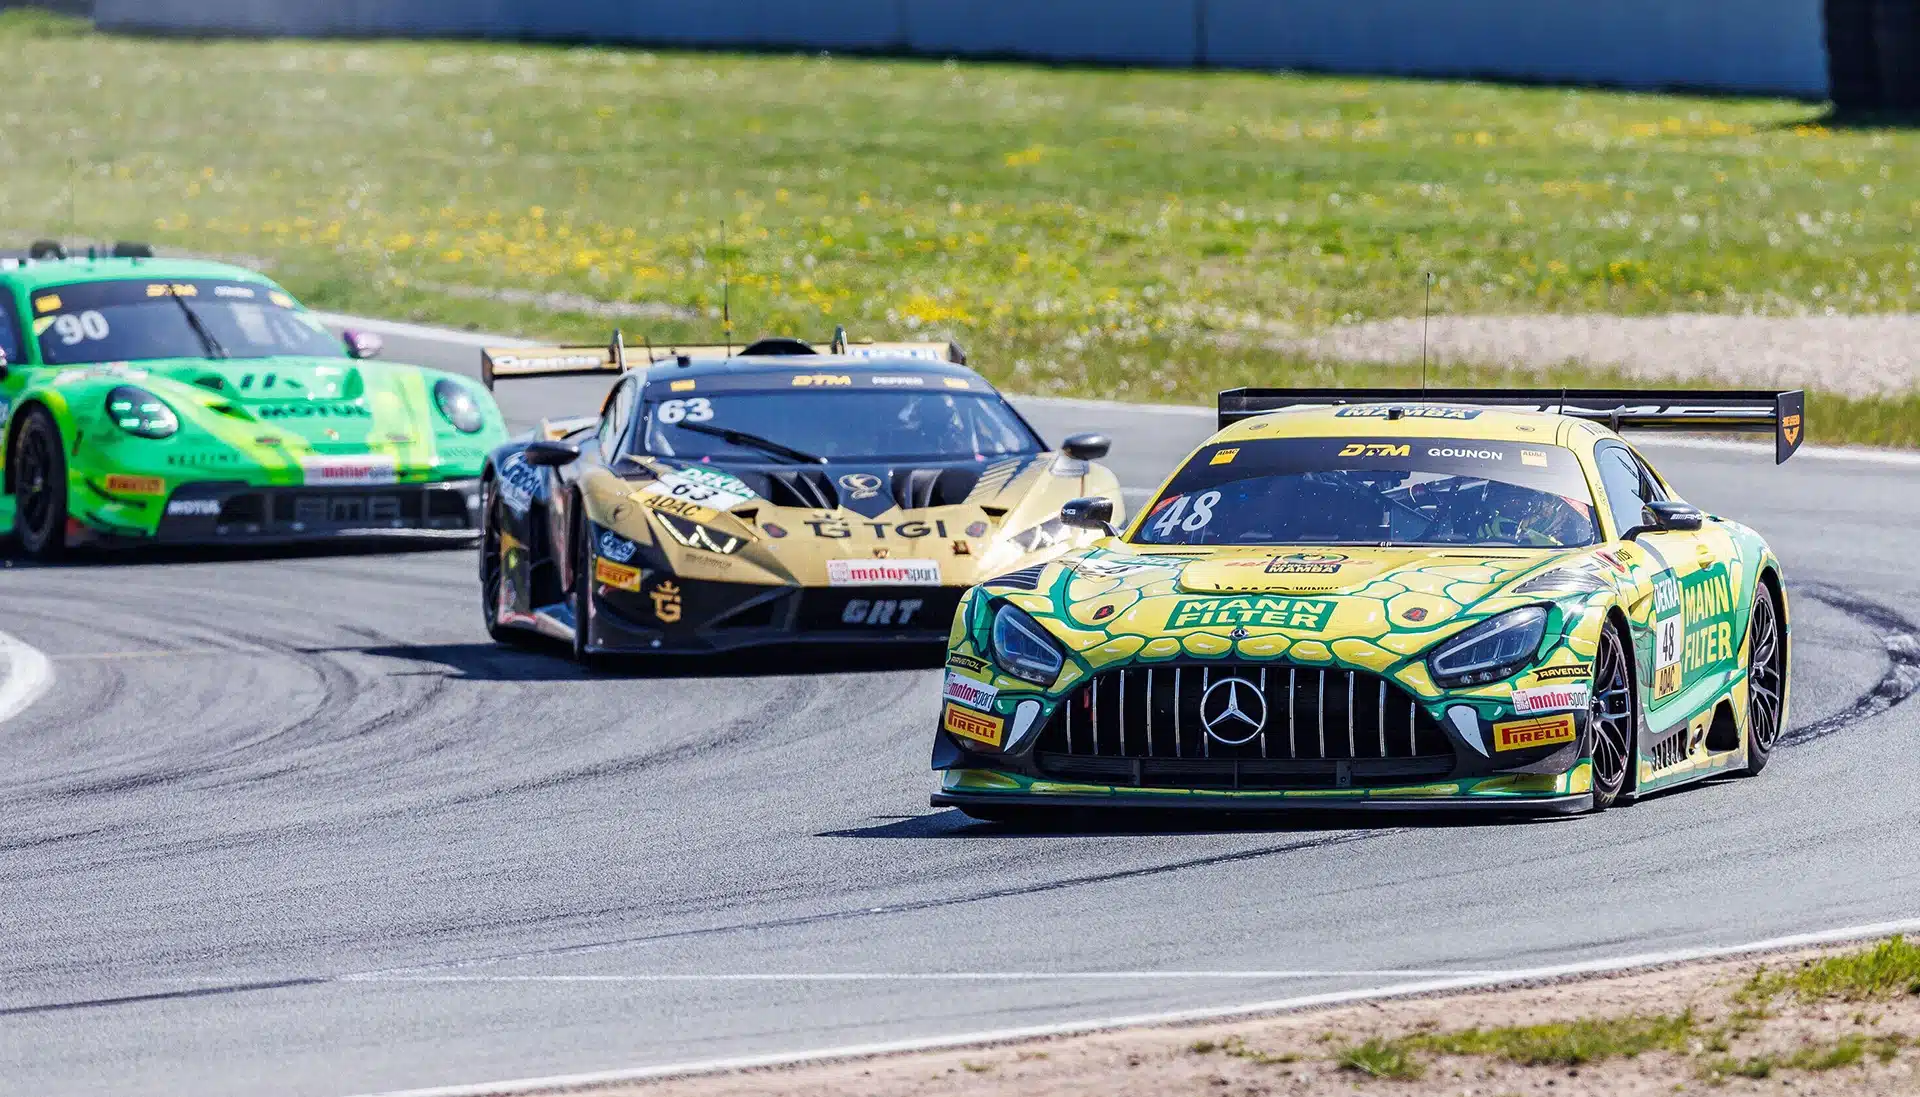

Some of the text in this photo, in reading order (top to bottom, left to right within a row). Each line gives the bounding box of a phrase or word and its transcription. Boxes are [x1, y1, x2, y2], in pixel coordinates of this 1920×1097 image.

[55, 310, 109, 345] 90
[792, 375, 852, 387] DTM
[658, 397, 714, 424] 63
[1338, 444, 1503, 461] DTM GOUNON
[645, 495, 702, 517] ADAC
[1154, 490, 1222, 537] 48
[863, 519, 948, 538] TGI
[851, 566, 939, 581] motorsport
[1181, 599, 1327, 614] MANN
[1654, 574, 1680, 615] DEKRA
[1685, 575, 1730, 627] MANN
[842, 599, 923, 624] GRT
[1174, 610, 1319, 628] FILTER
[1661, 621, 1675, 663] 48
[1683, 621, 1732, 674] FILTER
[949, 655, 980, 670] RAVENOL
[1540, 667, 1588, 678] RAVENOL
[1657, 666, 1675, 697] ADAC
[948, 682, 995, 709] motorsport
[1528, 691, 1588, 710] motorsport
[948, 708, 997, 739] PIRELLI
[1502, 720, 1569, 745] PIRELLI
